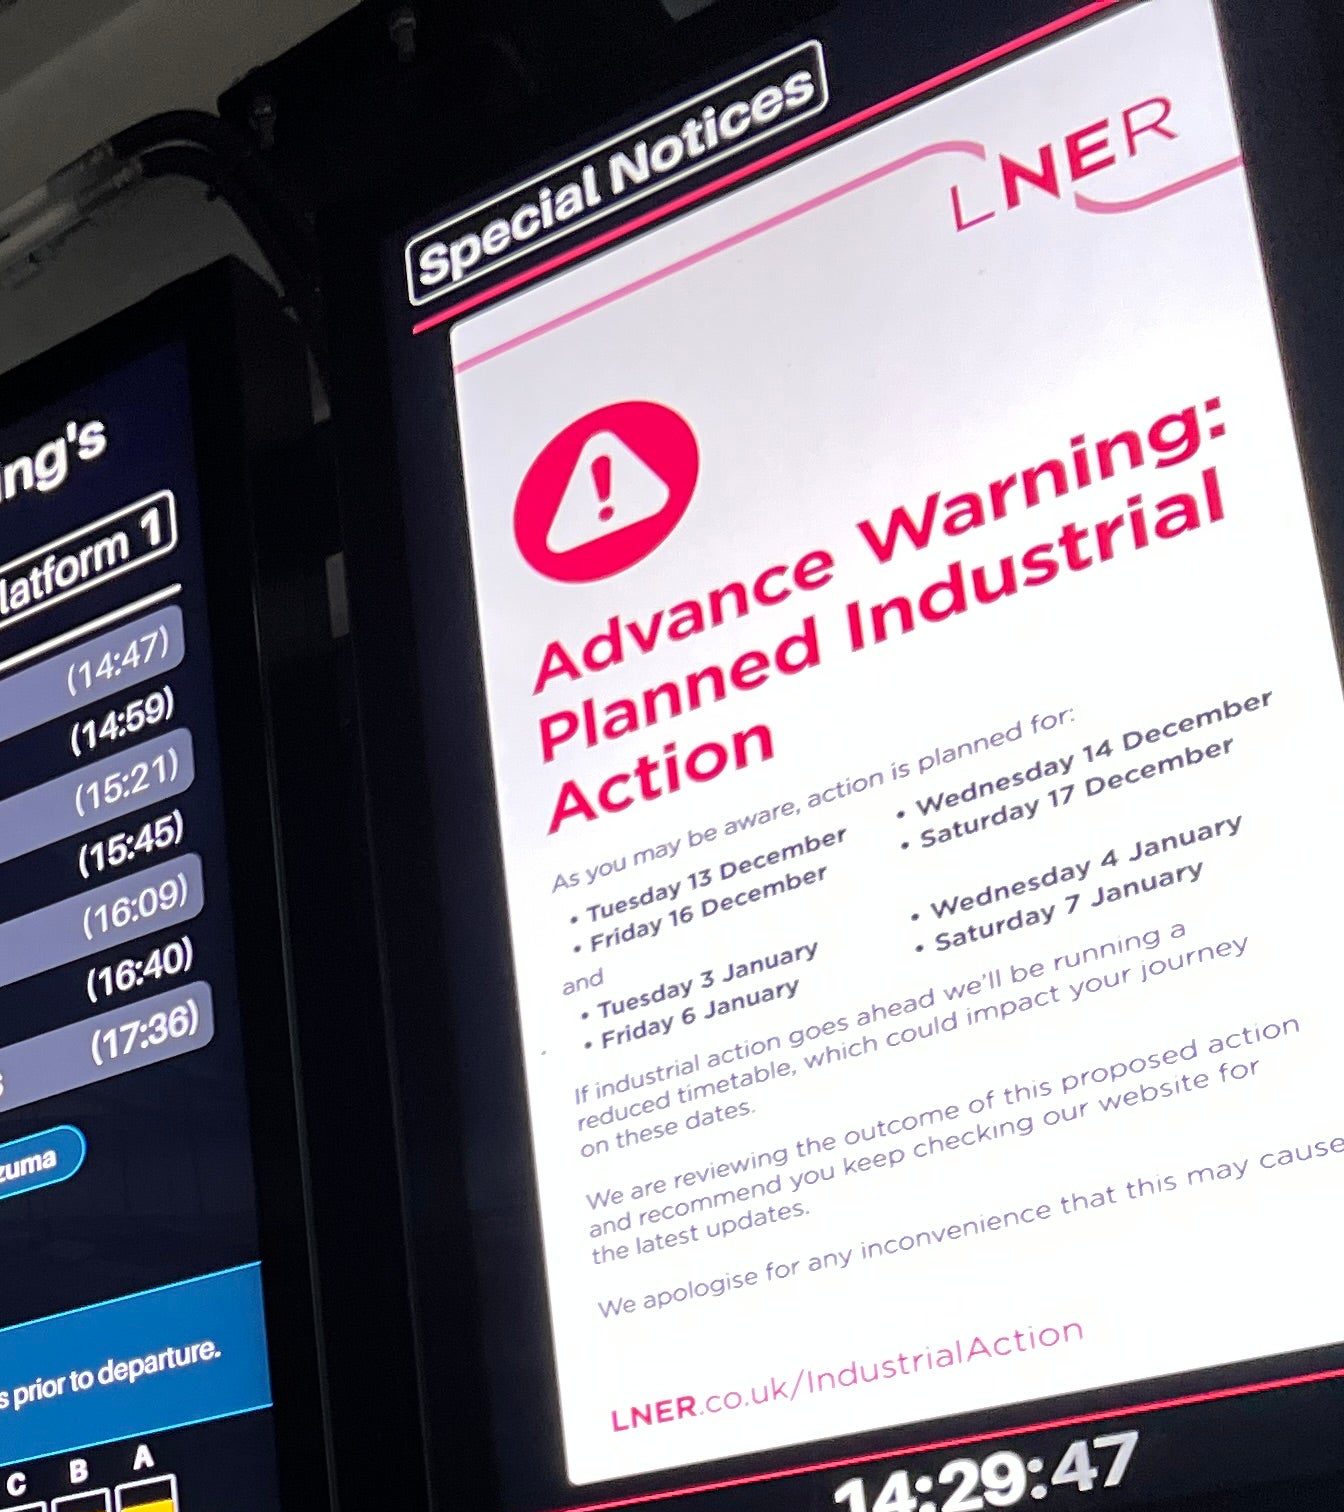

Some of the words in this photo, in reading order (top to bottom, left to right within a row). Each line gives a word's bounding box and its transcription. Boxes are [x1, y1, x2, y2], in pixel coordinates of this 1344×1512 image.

[418, 169, 601, 289] Special
[609, 65, 815, 196] Notices
[949, 95, 1179, 232] LNER
[140, 507, 161, 548] 1
[532, 548, 835, 695] Advance
[856, 395, 1228, 565] Warning:
[67, 624, 169, 696] (14:47)
[539, 618, 822, 764] Planned
[845, 468, 1226, 653] Industrial
[71, 685, 175, 756] (14:59)
[916, 754, 1075, 817] Wednesday
[1082, 739, 1114, 764] 14
[1123, 690, 1273, 751] December
[74, 747, 179, 816] (15:21)
[545, 723, 775, 835] Action
[551, 872, 580, 894] As
[586, 858, 627, 884] you
[634, 838, 681, 868] may
[688, 827, 718, 847] be
[724, 801, 801, 836] aware,
[808, 771, 884, 807] action
[890, 761, 910, 780] is
[917, 722, 1022, 774] planned
[1030, 707, 1076, 735] for:
[921, 798, 1040, 848] Saturday
[1048, 784, 1075, 808] 17
[1086, 736, 1233, 797] December
[78, 809, 183, 878] (15:45)
[587, 880, 681, 922] Tuesday
[688, 869, 713, 890] 13
[720, 828, 847, 880] December
[931, 859, 1090, 920] Wednesday
[1101, 849, 1118, 867] 4
[1129, 815, 1243, 862] January
[82, 872, 188, 939] (16:09)
[591, 917, 662, 952] Friday
[670, 907, 694, 927] 16
[702, 866, 827, 917] December
[935, 904, 1055, 952] Saturday
[1065, 893, 1080, 914] 7
[1091, 861, 1203, 908] January
[86, 936, 193, 1003] (16:40)
[562, 968, 604, 996] and
[575, 1086, 589, 1105] If
[596, 1055, 700, 1098] industrial
[707, 1037, 781, 1069] action
[789, 1016, 849, 1049] goes
[856, 988, 935, 1029] ahead
[1010, 958, 1045, 983] be
[1055, 925, 1161, 972] running
[1171, 923, 1186, 939] a
[597, 978, 693, 1019] Tuesday
[701, 971, 714, 988] 3
[723, 942, 818, 983] January
[601, 1015, 674, 1050] Friday
[682, 1007, 696, 1024] 6
[704, 978, 800, 1020] January
[90, 1000, 200, 1067] (17:36)
[577, 1092, 669, 1132] reduced
[678, 1060, 797, 1105] timetable,
[804, 1037, 878, 1069] which
[886, 1013, 958, 1048] could
[967, 987, 1060, 1028] impact
[1069, 968, 1130, 1002] your
[1141, 936, 1248, 983] journey
[581, 1138, 609, 1158] on
[615, 1120, 678, 1150] these
[685, 1104, 756, 1131] dates.
[586, 1188, 624, 1211] We
[631, 1181, 666, 1202] are
[674, 1147, 788, 1189] reviewing
[796, 1132, 836, 1158] the
[844, 1103, 959, 1145] outcome
[969, 1090, 995, 1113] of
[1004, 1078, 1052, 1106] this
[1062, 1039, 1198, 1095] proposed
[1208, 1017, 1299, 1054] action
[589, 1212, 631, 1240] and
[639, 1174, 781, 1227] recommend
[790, 1165, 835, 1195] you
[843, 1145, 905, 1178] keep
[913, 1113, 1033, 1159] checking
[1043, 1101, 1089, 1126] our
[1099, 1072, 1209, 1112] website
[1219, 1058, 1260, 1084] for
[591, 1242, 629, 1265] the
[636, 1224, 699, 1255] latest
[707, 1198, 810, 1240] updates.
[598, 1296, 636, 1319] We
[643, 1270, 758, 1309] apologise
[766, 1258, 800, 1281] for
[808, 1247, 852, 1273] any
[862, 1202, 1051, 1260] inconvenience
[1061, 1185, 1117, 1215] that
[1126, 1171, 1177, 1200] this
[1187, 1157, 1249, 1186] may
[1259, 1137, 1344, 1169] cause
[14, 1377, 67, 1411] prior
[70, 1369, 93, 1391] to
[97, 1340, 222, 1389] departure.
[611, 1318, 1084, 1434] LNER.co.uk/IndustrialAction
[7, 1472, 27, 1496] C
[69, 1459, 88, 1484] B
[133, 1444, 154, 1470] A
